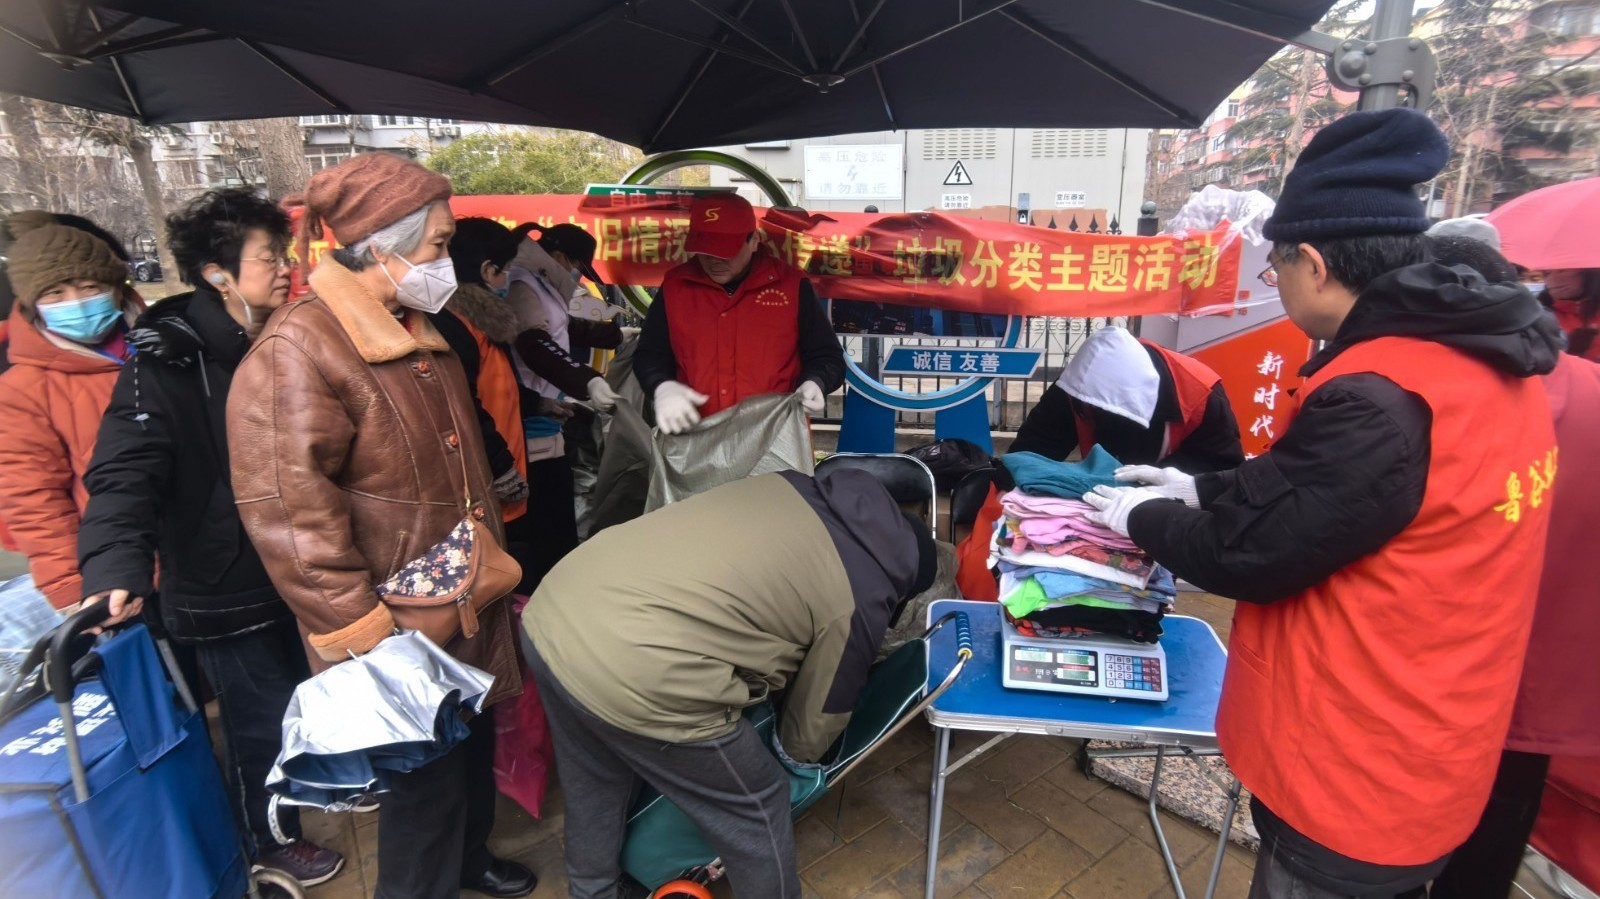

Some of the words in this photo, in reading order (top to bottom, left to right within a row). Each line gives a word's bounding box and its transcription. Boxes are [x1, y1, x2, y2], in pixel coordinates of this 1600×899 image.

[817, 150, 887, 163] 高压危险
[818, 182, 887, 195] 请勿靠近
[893, 233, 1219, 292] 垃圾分类主题活动
[912, 351, 952, 371] 诚信
[959, 352, 1000, 373] 友善
[1244, 351, 1284, 461] 新时代
